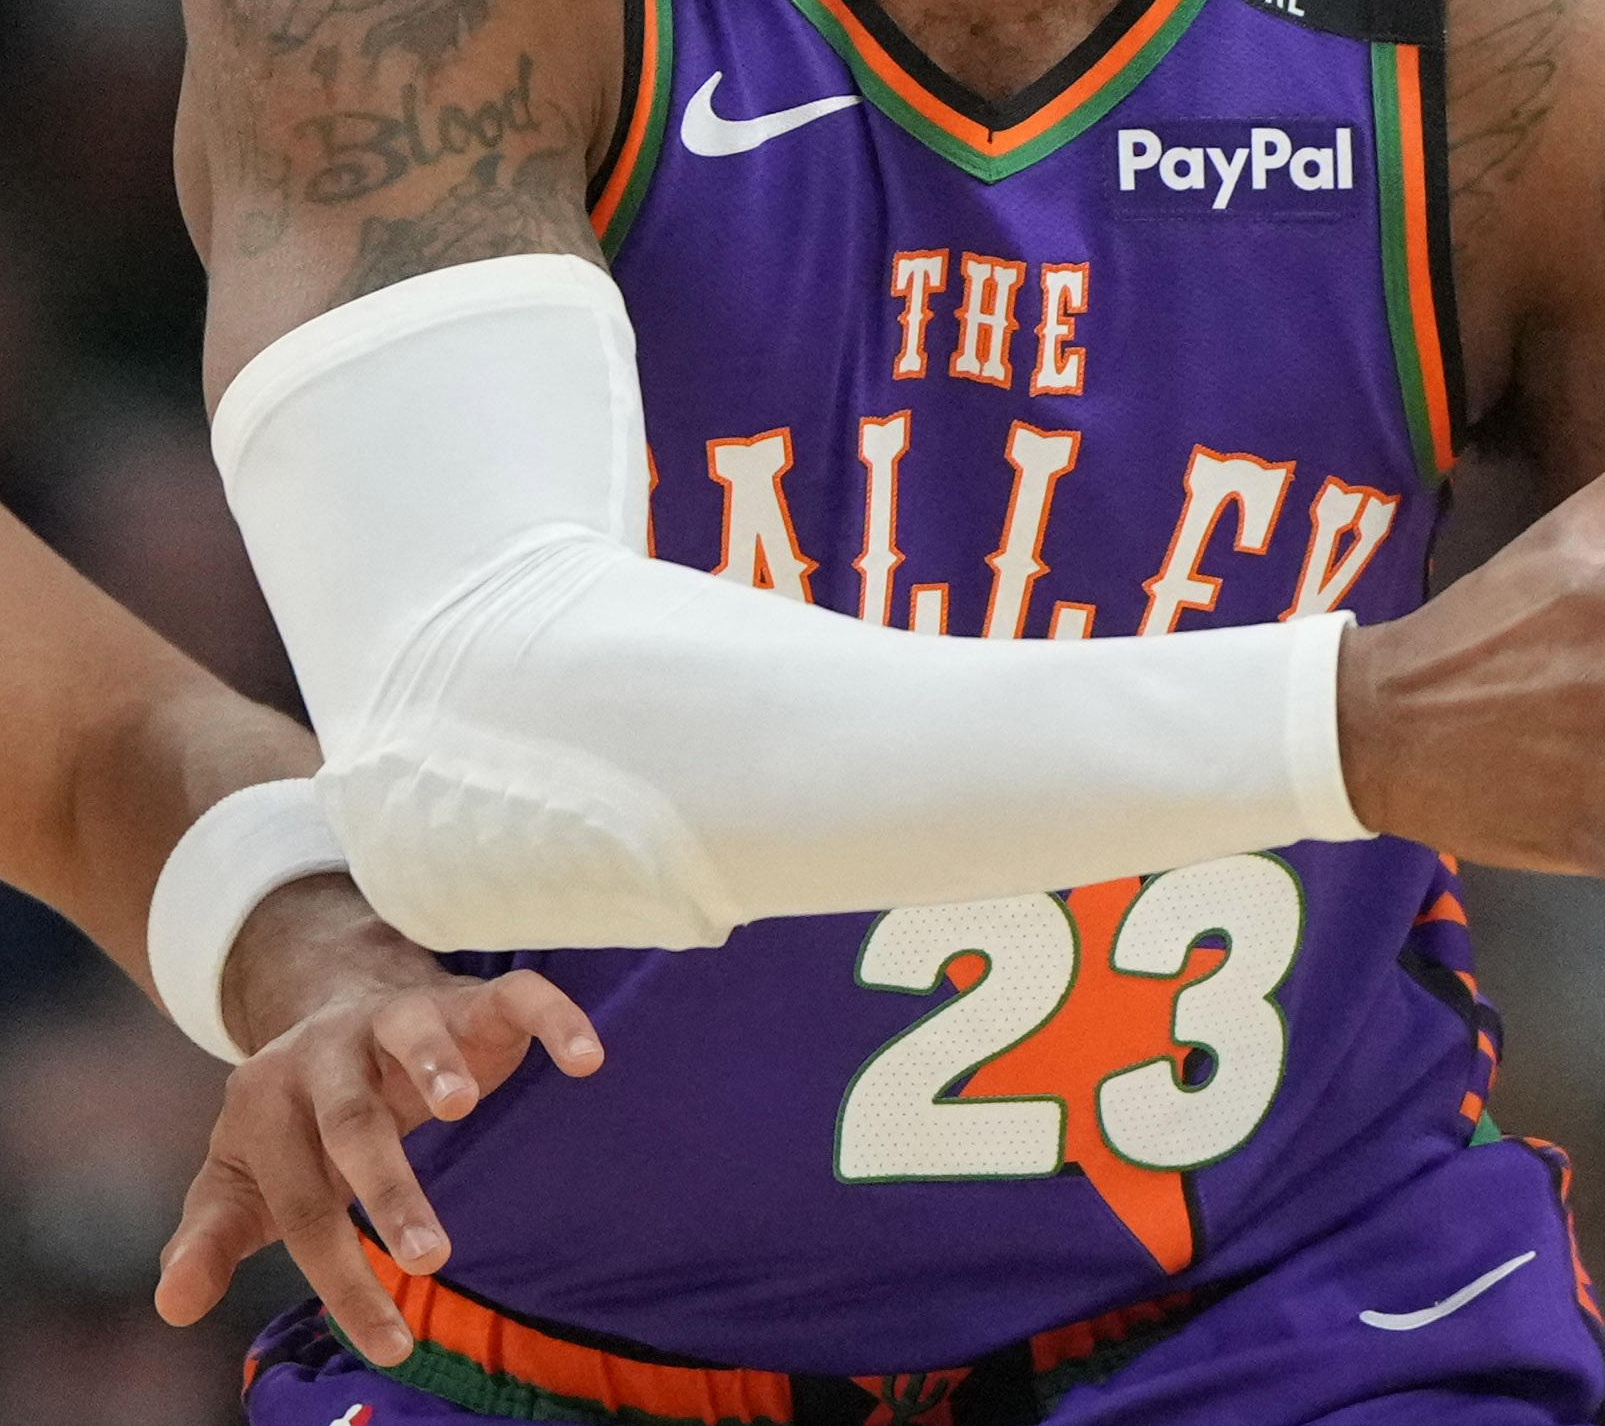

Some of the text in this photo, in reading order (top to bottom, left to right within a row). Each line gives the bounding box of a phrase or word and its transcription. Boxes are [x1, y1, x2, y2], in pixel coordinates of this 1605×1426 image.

[1117, 127, 1354, 210] PayPal
[890, 247, 1090, 397] THE
[646, 409, 1399, 640] ALLEY
[832, 849, 1307, 1184] 23
